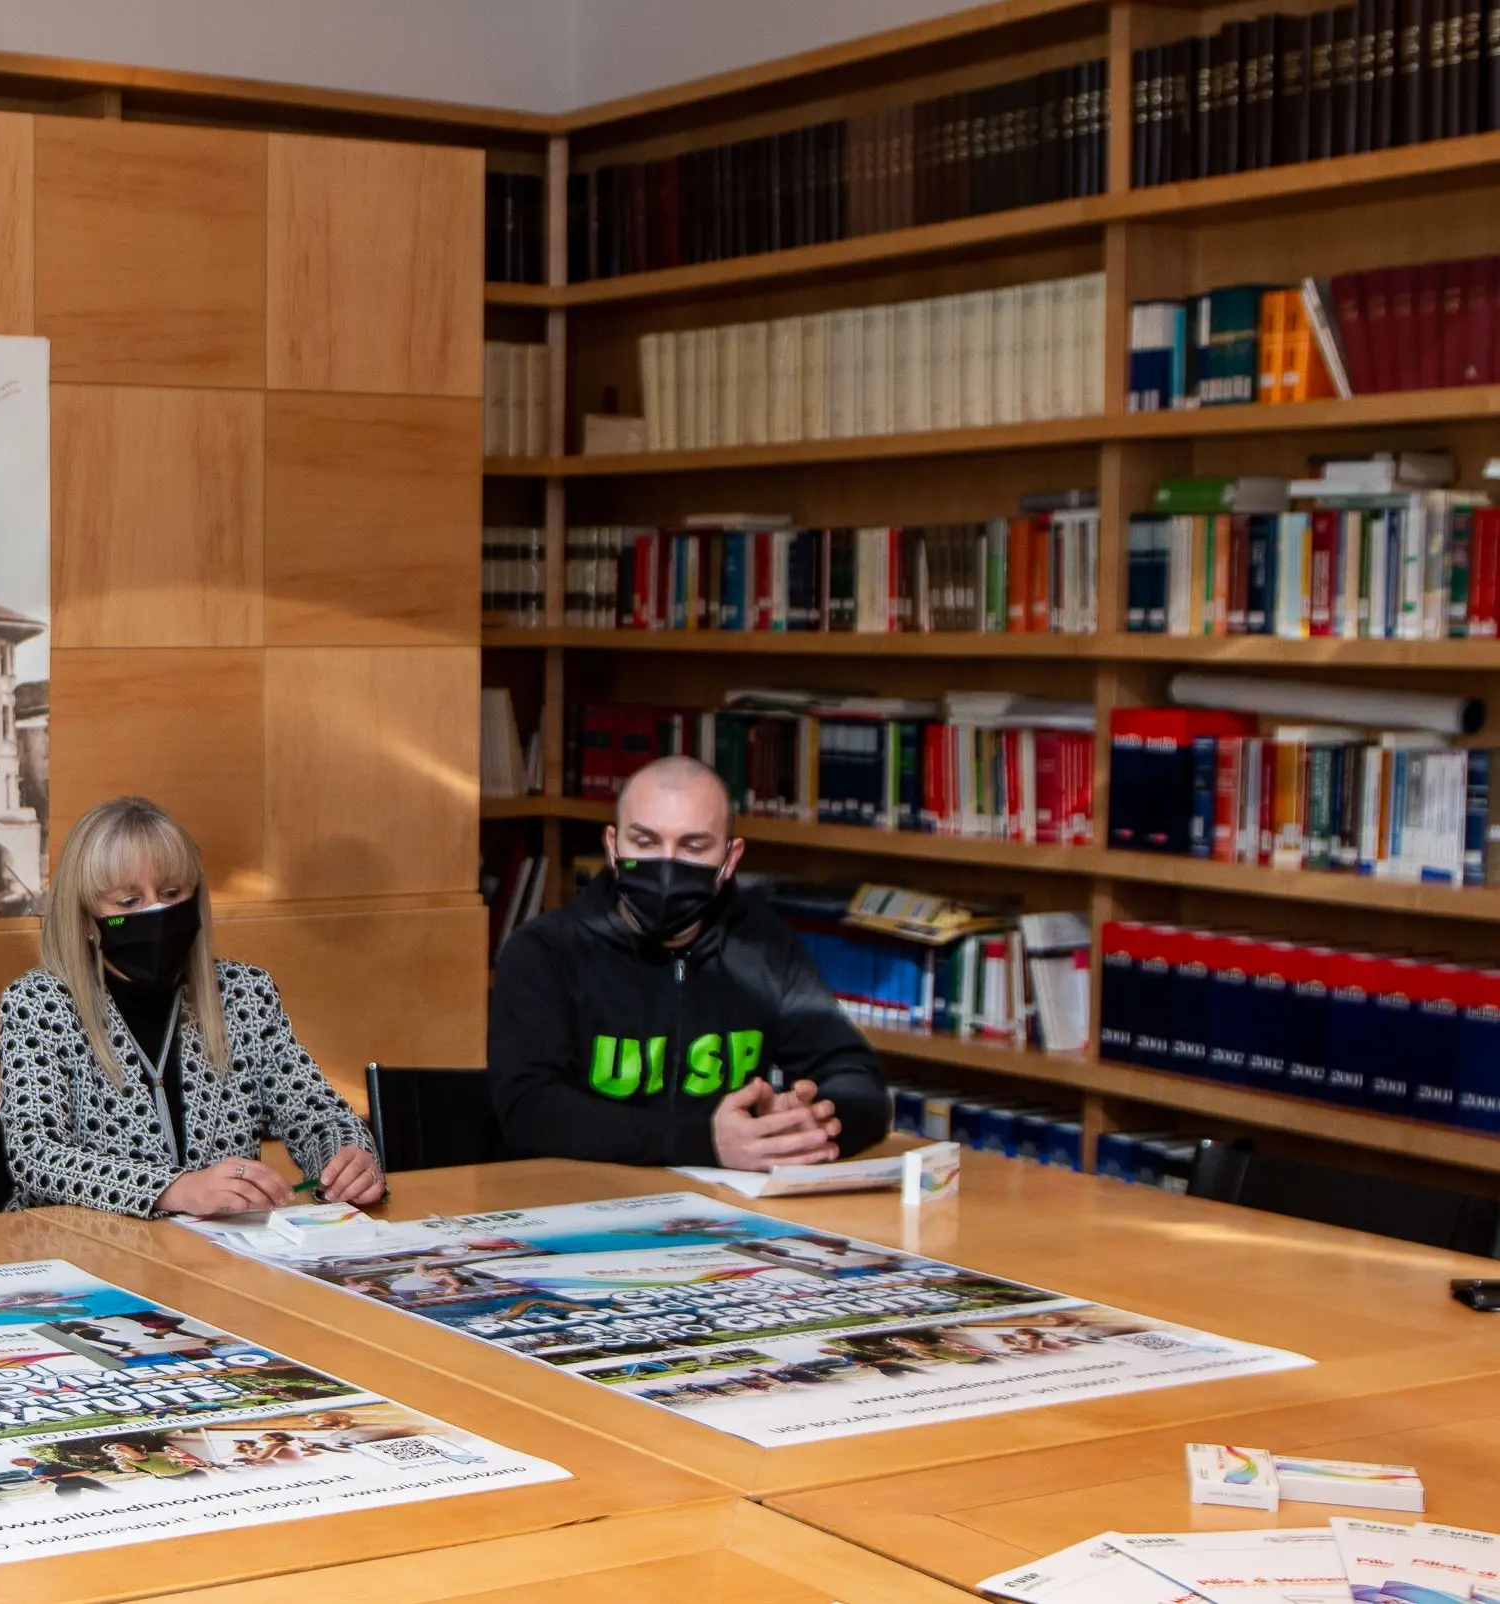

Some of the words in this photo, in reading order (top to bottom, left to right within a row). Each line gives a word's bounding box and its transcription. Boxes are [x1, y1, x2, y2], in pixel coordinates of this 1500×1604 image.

[610, 1273, 779, 1304] CHIEDI
[595, 1323, 713, 1349] sono
[24, 1515, 190, 1546] bolzano@uisp.it
[203, 1494, 322, 1520] 0471300057
[338, 1464, 529, 1500] www.uisp.it/bolzano
